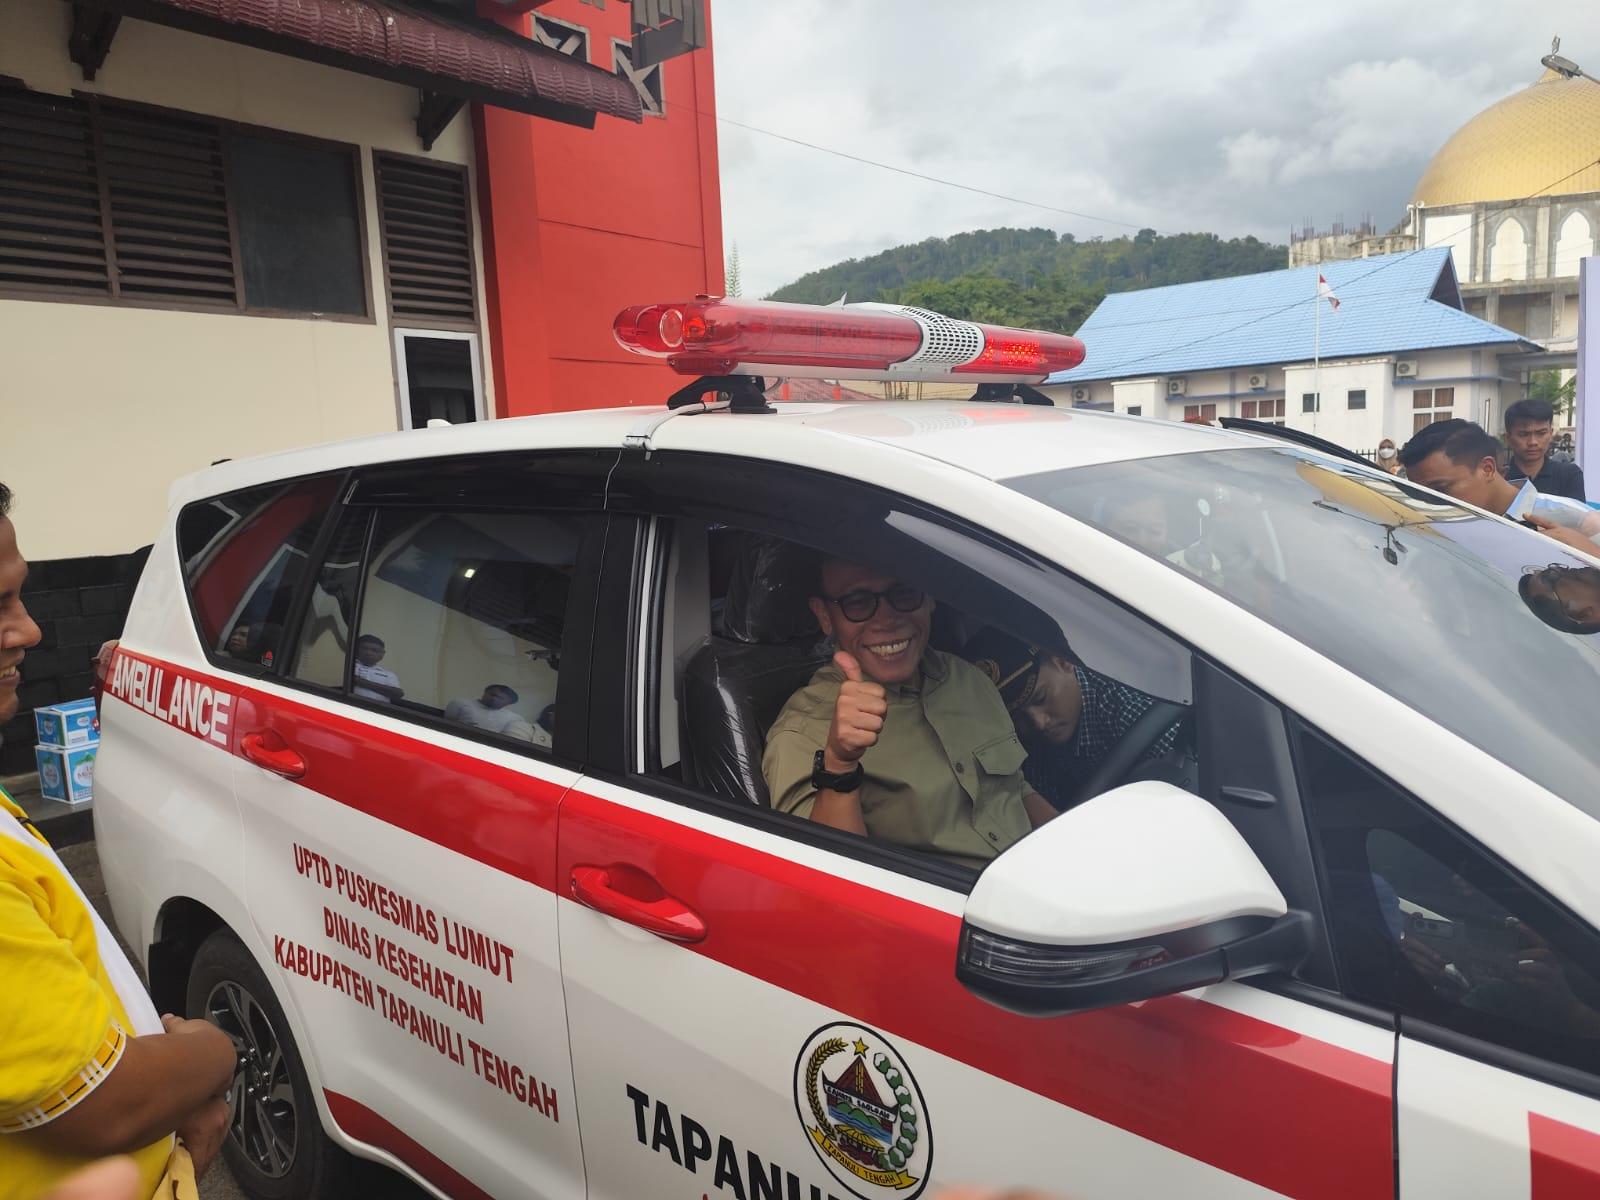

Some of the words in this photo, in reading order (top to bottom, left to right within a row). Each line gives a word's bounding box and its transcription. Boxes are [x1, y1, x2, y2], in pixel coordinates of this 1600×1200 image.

[111, 654, 233, 746] AMBULANCE
[293, 842, 332, 889] UPTD
[335, 864, 440, 945] PUSKESMAS
[443, 917, 514, 983] LUMUT
[323, 906, 372, 960] DINAS
[374, 933, 484, 1025] KESEHATAN
[274, 935, 375, 1010] KABUPATEN
[377, 985, 465, 1067] TAPANULI
[468, 1038, 559, 1123] TENGAH
[827, 1143, 860, 1174] TAPANULI
[864, 1170, 896, 1184] TENGAH
